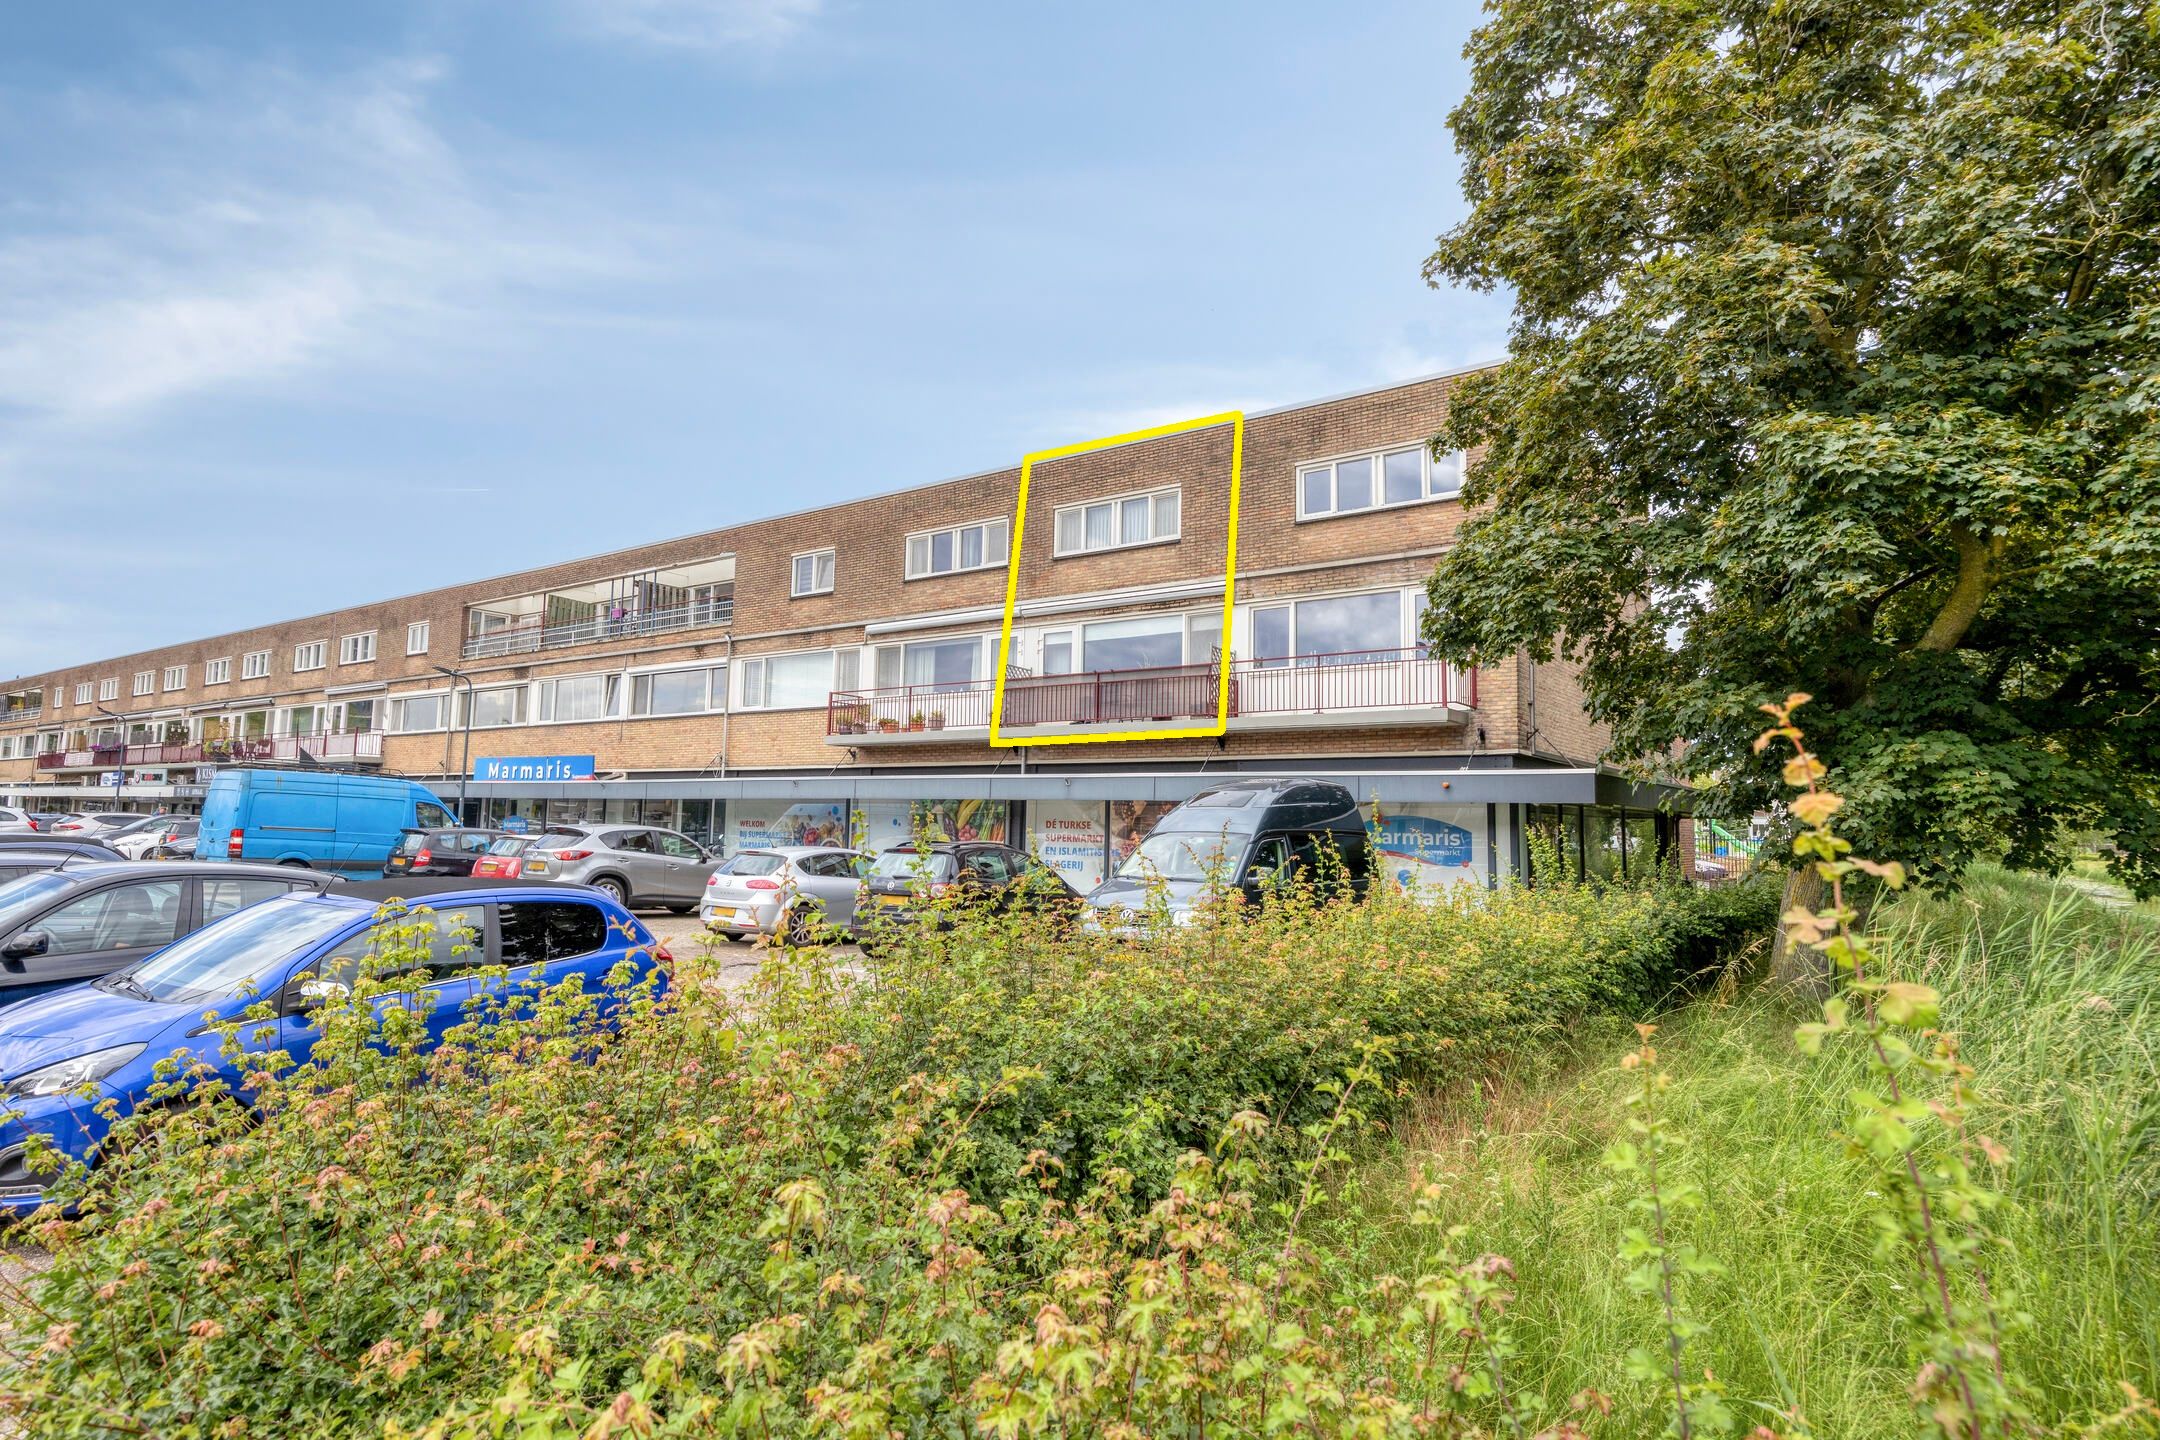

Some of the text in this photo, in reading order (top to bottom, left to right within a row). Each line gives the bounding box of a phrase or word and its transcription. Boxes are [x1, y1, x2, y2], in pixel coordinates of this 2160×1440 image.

[488, 760, 572, 779] Marmaris
[740, 820, 765, 828] WELKOM
[1045, 818, 1092, 830] DÉ TURKSE
[1045, 833, 1104, 844] SUPERMARKT
[1370, 829, 1461, 846] armaris
[739, 841, 771, 849] MARMARIS
[1045, 847, 1057, 856] EN
